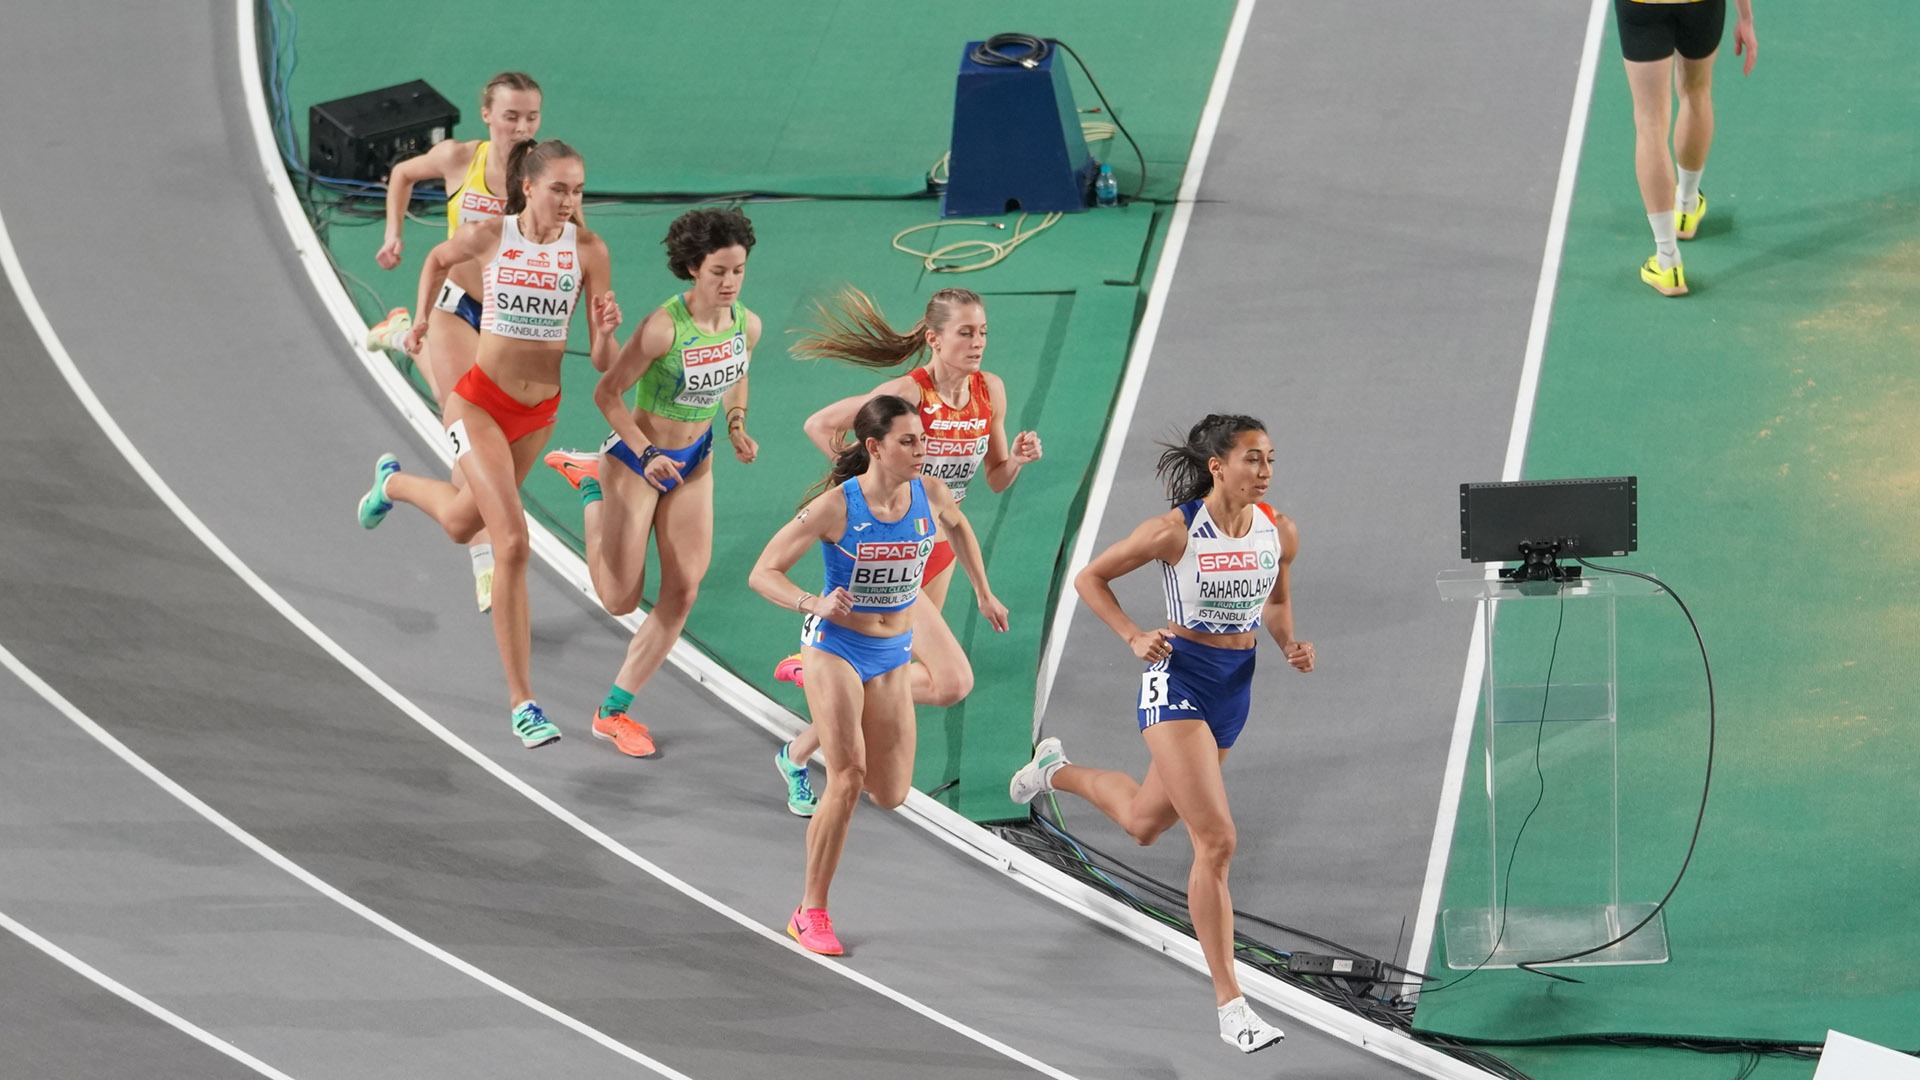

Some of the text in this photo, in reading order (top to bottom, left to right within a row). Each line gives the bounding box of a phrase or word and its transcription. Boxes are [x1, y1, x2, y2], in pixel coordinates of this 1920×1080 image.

[463, 193, 505, 214] SPA
[502, 249, 524, 260] 4F
[498, 268, 556, 289] SPAR
[497, 293, 568, 316] SARNA
[685, 343, 732, 365] SPAR
[688, 361, 745, 391] SADEK
[929, 418, 987, 431] ESPAÑA
[450, 431, 461, 454] 3
[926, 441, 976, 456] SPAR
[860, 545, 917, 560] SPAR
[1200, 553, 1257, 570] SPAR
[855, 561, 924, 584] BELLO
[889, 585, 911, 593] CLEAN
[1199, 577, 1275, 598] RAHAROLAHY
[804, 614, 815, 637] 4
[1199, 609, 1247, 621] ISTANBUL
[1149, 676, 1159, 703] 5
